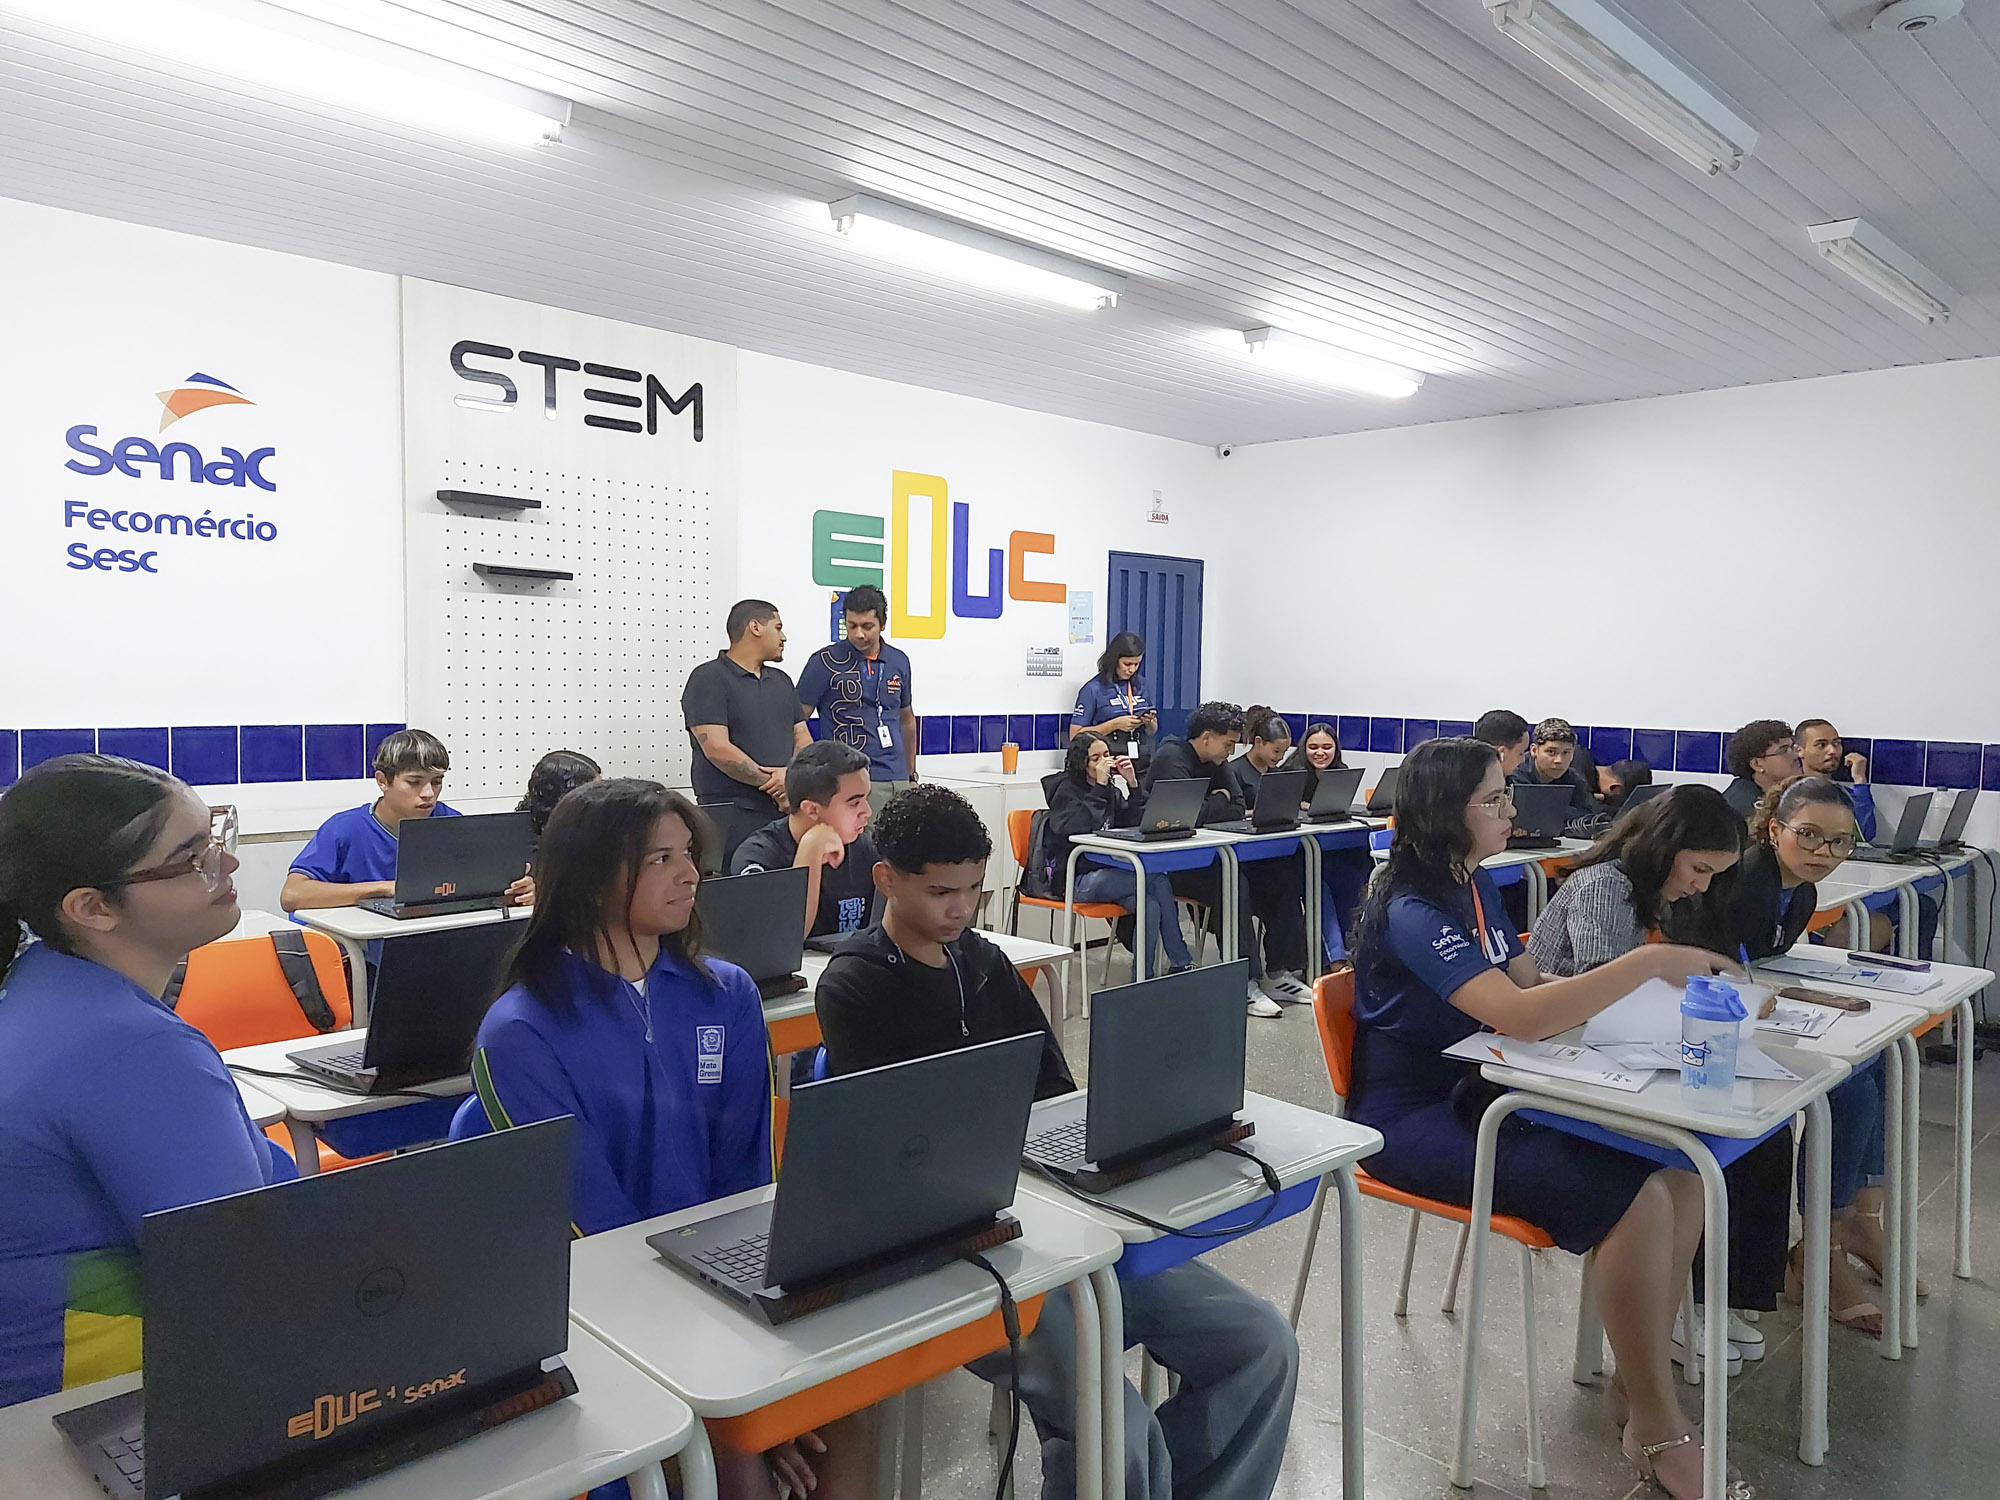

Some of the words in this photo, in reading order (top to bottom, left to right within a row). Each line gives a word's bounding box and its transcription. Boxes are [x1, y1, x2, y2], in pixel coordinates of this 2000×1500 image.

[450, 340, 703, 443] STEM
[64, 424, 276, 492] Senac
[64, 500, 278, 542] Fecomércio
[66, 542, 158, 573] Sesc
[812, 469, 1067, 640] EDUC
[287, 1389, 382, 1440] EDUC
